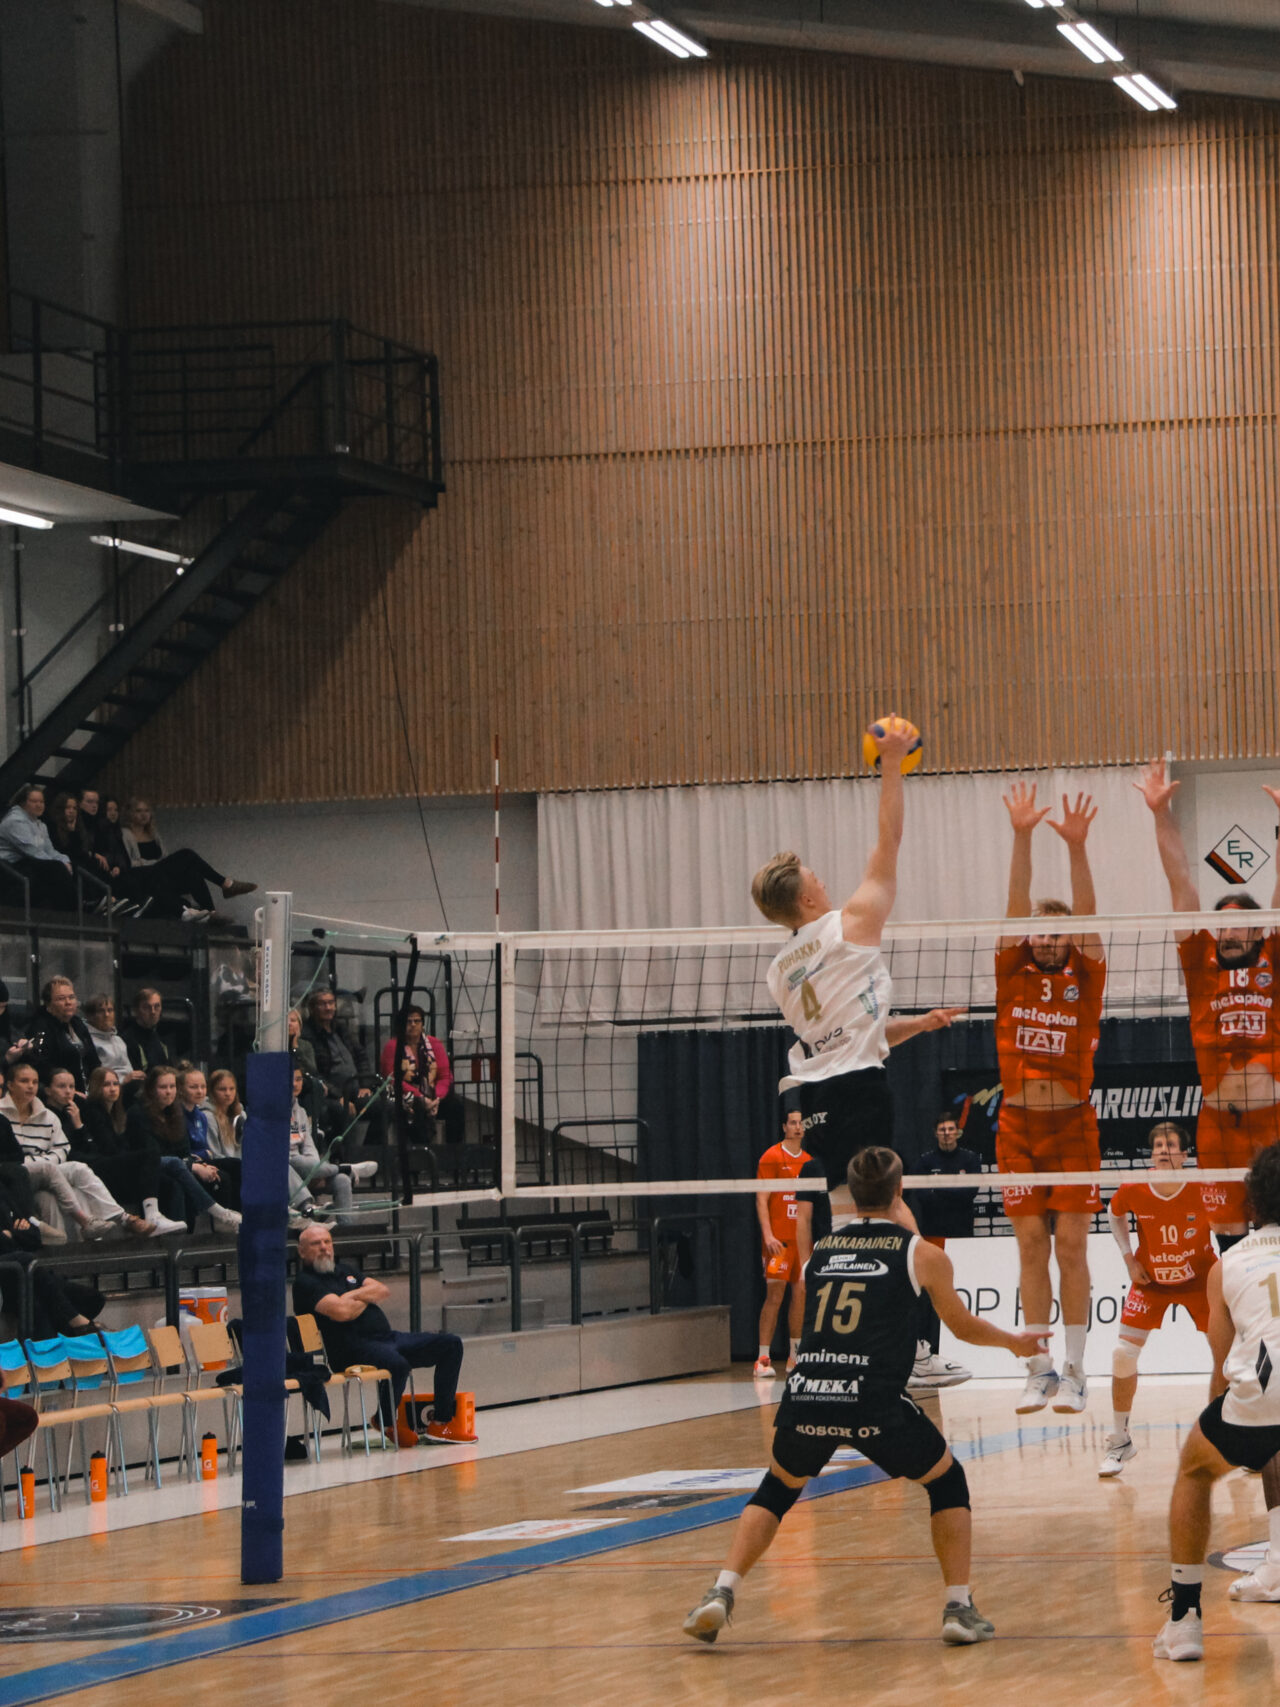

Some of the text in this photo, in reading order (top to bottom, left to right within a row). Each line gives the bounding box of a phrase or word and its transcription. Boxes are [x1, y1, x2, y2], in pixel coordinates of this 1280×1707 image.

[1040, 978, 1052, 1002] 3
[801, 979, 822, 1022] 4
[1012, 1006, 1077, 1026] metaplan
[1221, 1014, 1261, 1031] TAI
[1022, 1031, 1062, 1050] TAI
[1089, 1085, 1204, 1120] ARUUSLII
[817, 1235, 903, 1251] HAKKARAINEN
[1159, 1224, 1179, 1243] 10
[820, 1262, 876, 1273] SAARELAINEN
[814, 1281, 867, 1334] 15
[802, 1379, 859, 1394] MEKA
